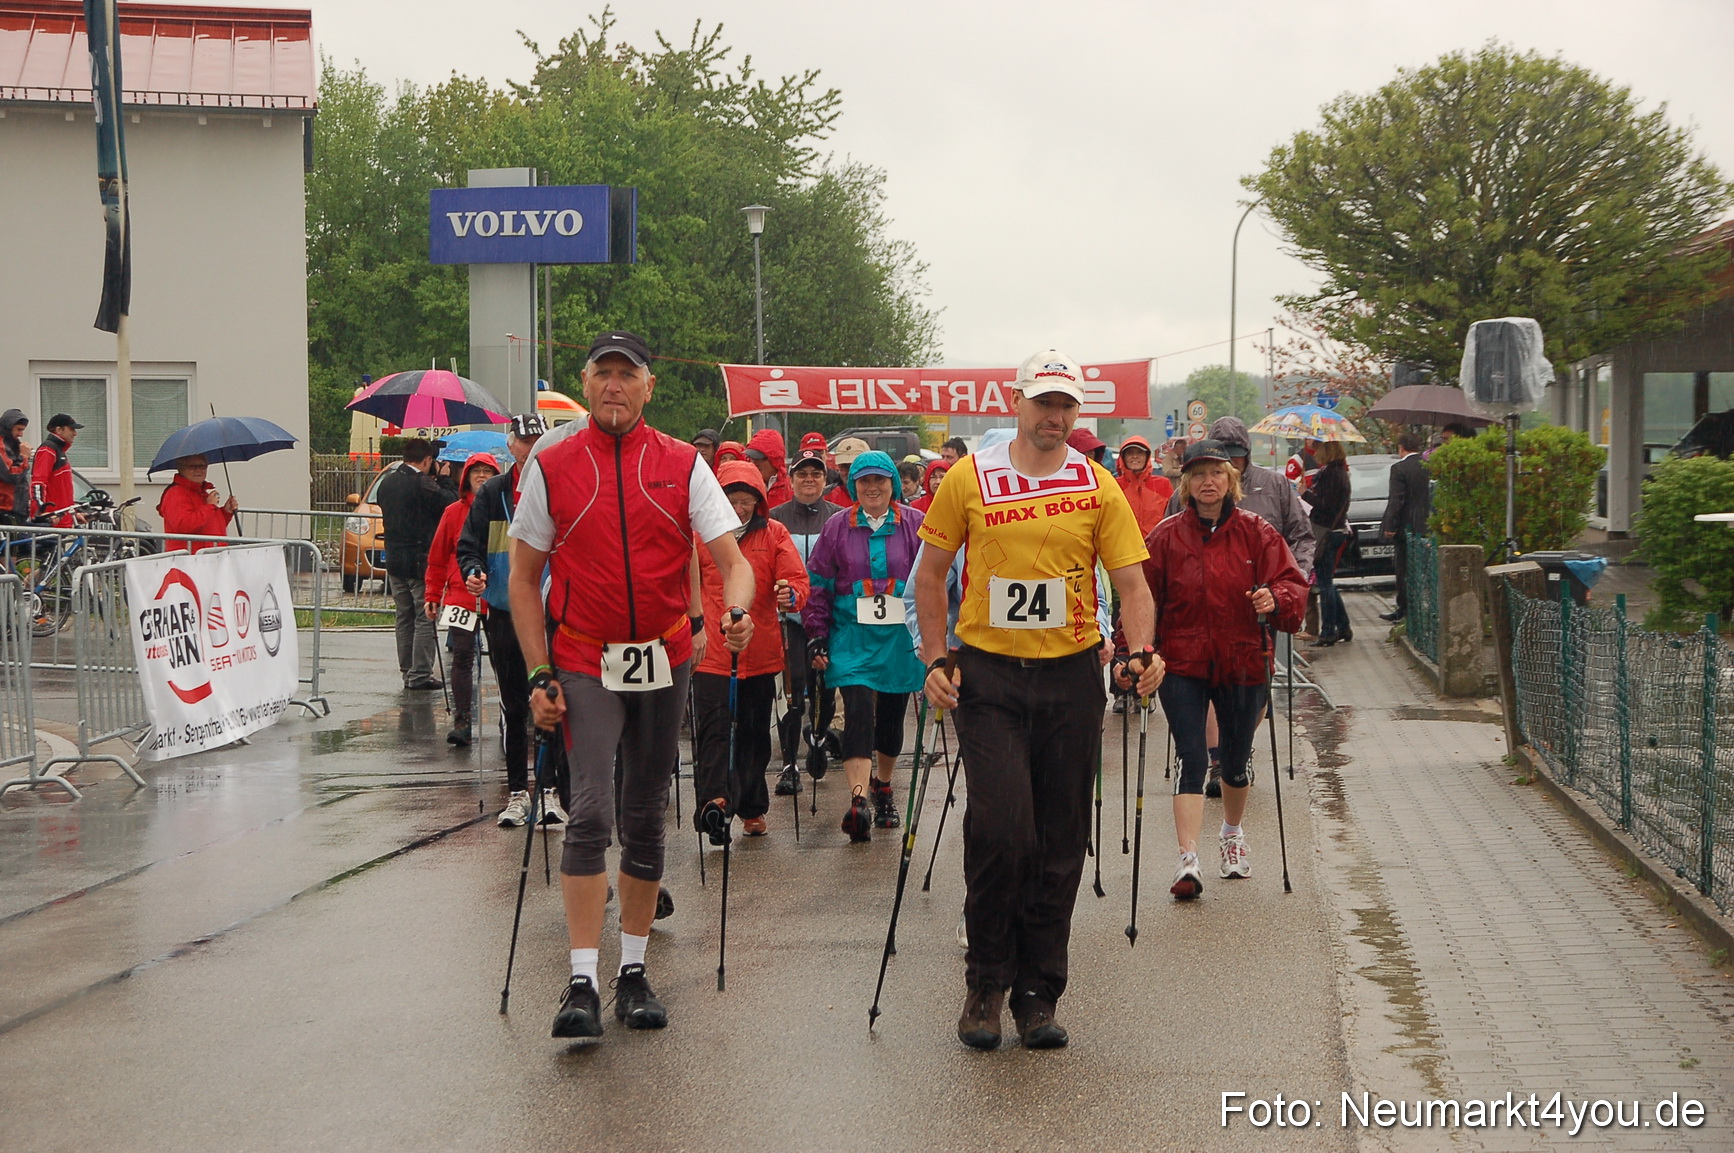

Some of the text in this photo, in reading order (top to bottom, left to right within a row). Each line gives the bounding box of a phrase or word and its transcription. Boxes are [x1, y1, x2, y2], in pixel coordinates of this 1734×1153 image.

[446, 209, 583, 237] VOLVO
[1035, 371, 1076, 382] RACING
[1193, 406, 1203, 416] 60
[985, 496, 1101, 527] MAX BÖGL
[873, 595, 887, 620] 3
[1006, 582, 1050, 622] 24
[448, 607, 471, 625] 38
[622, 645, 655, 684] 21
